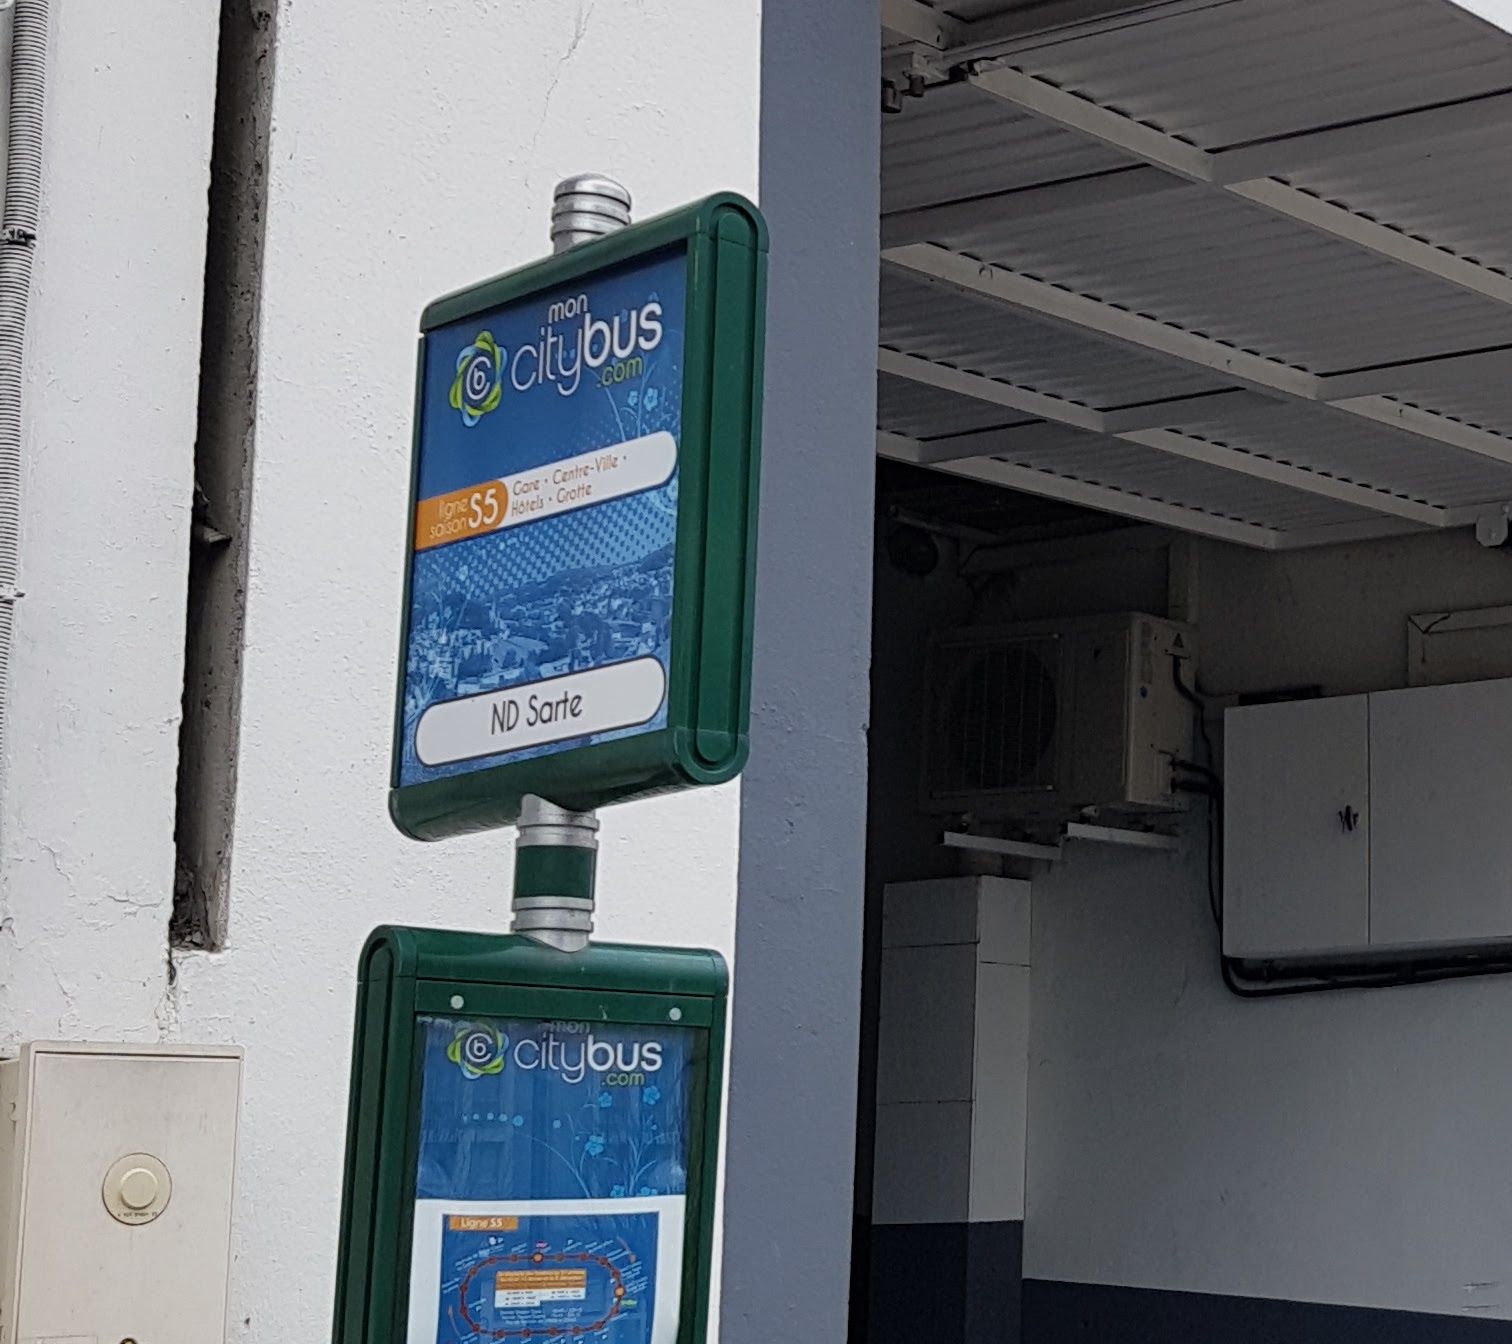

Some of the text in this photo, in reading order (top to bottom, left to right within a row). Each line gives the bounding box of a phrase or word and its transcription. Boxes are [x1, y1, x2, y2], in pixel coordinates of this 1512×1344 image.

[549, 293, 588, 323] mon
[511, 302, 663, 396] citybus
[512, 454, 619, 497] Gare Centre-Ville
[555, 482, 593, 504] Grotte
[428, 516, 468, 539] saison
[438, 498, 469, 520] ligne
[467, 487, 499, 529] S5
[490, 690, 583, 736] ND Sarte
[513, 1031, 664, 1084] citybus
